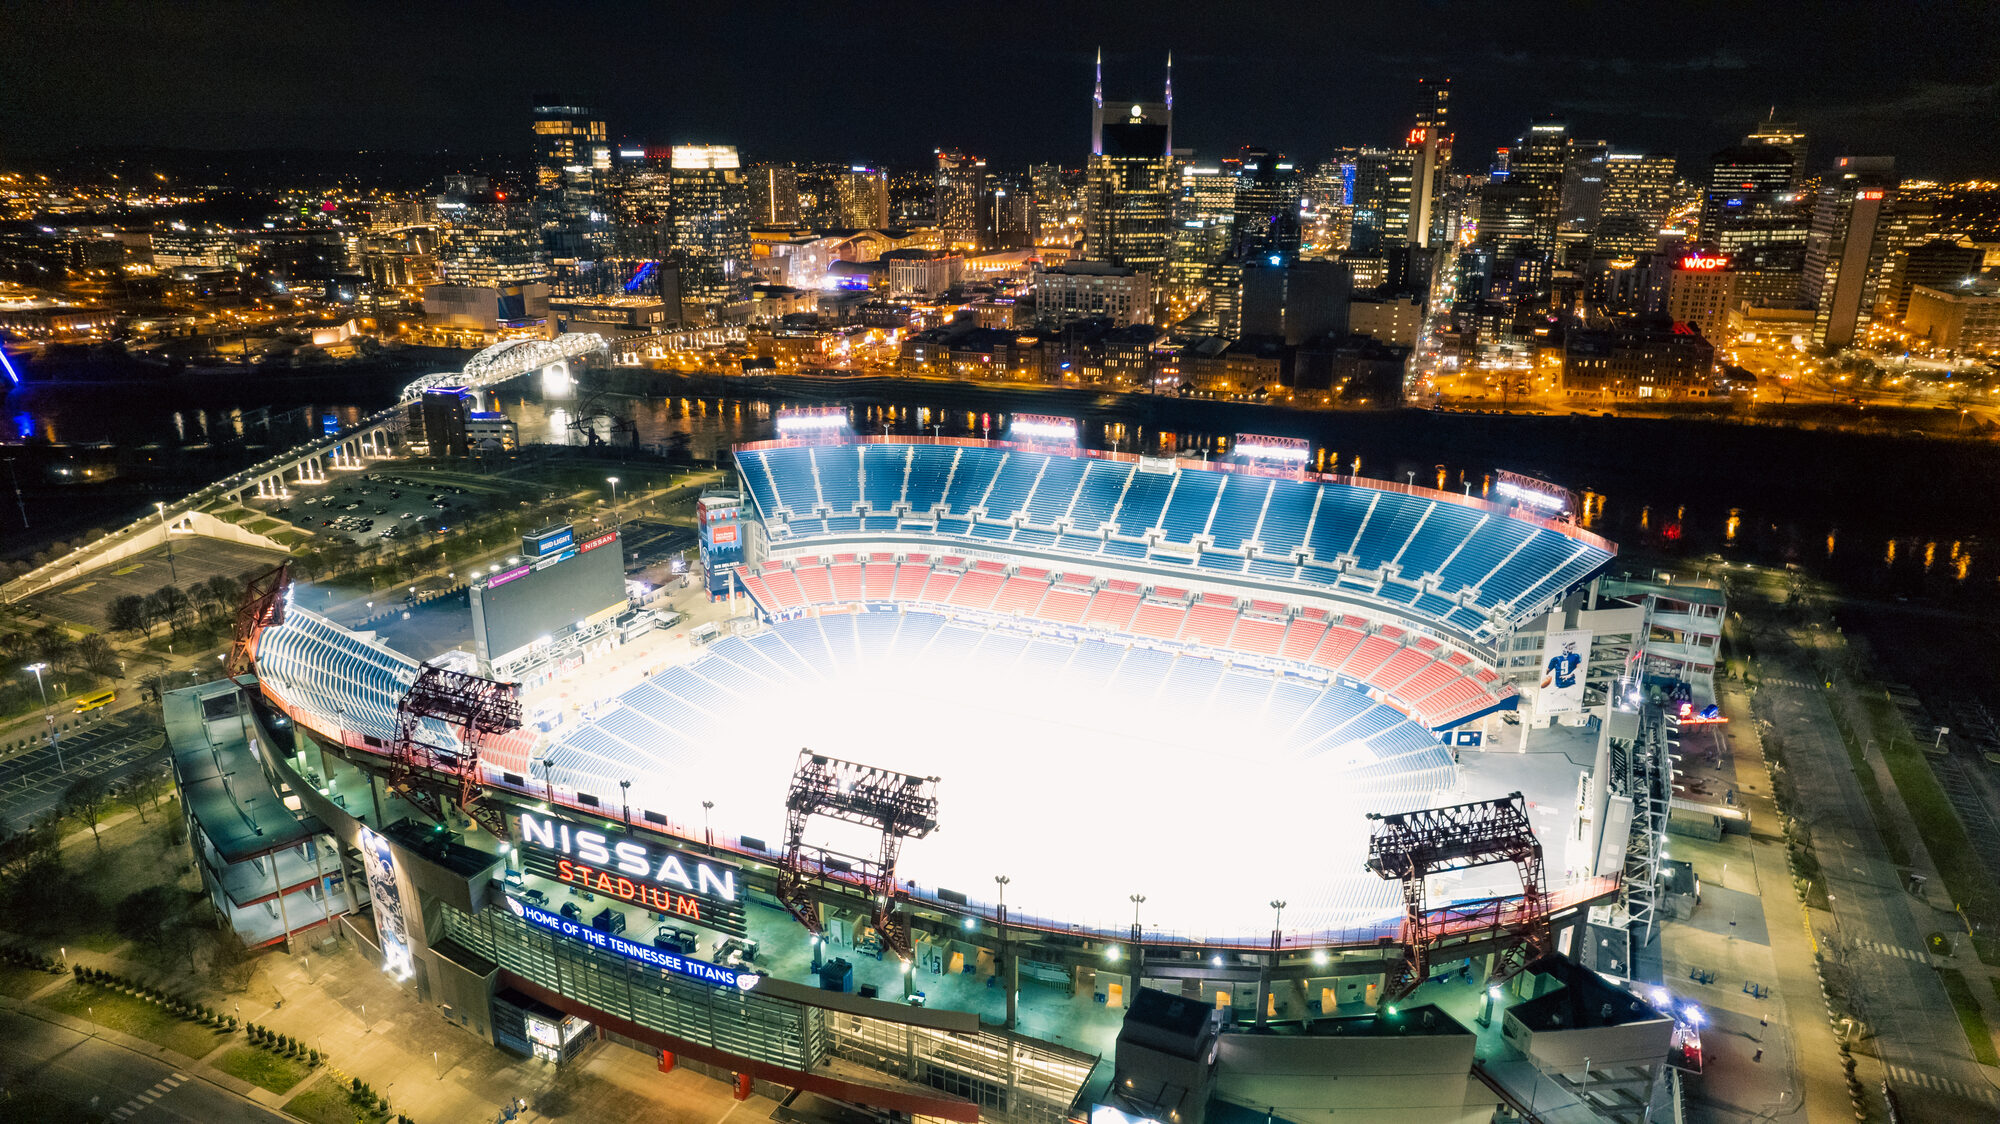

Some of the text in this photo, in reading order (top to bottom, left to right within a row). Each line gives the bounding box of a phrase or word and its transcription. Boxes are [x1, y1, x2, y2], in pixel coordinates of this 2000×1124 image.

[585, 535, 613, 550] NISSAN
[1560, 660, 1569, 676] 9
[521, 813, 735, 901] NISSAN
[558, 860, 701, 921] STADIUM
[526, 907, 735, 985] HOME OF THE TENNESSEE TITANS
